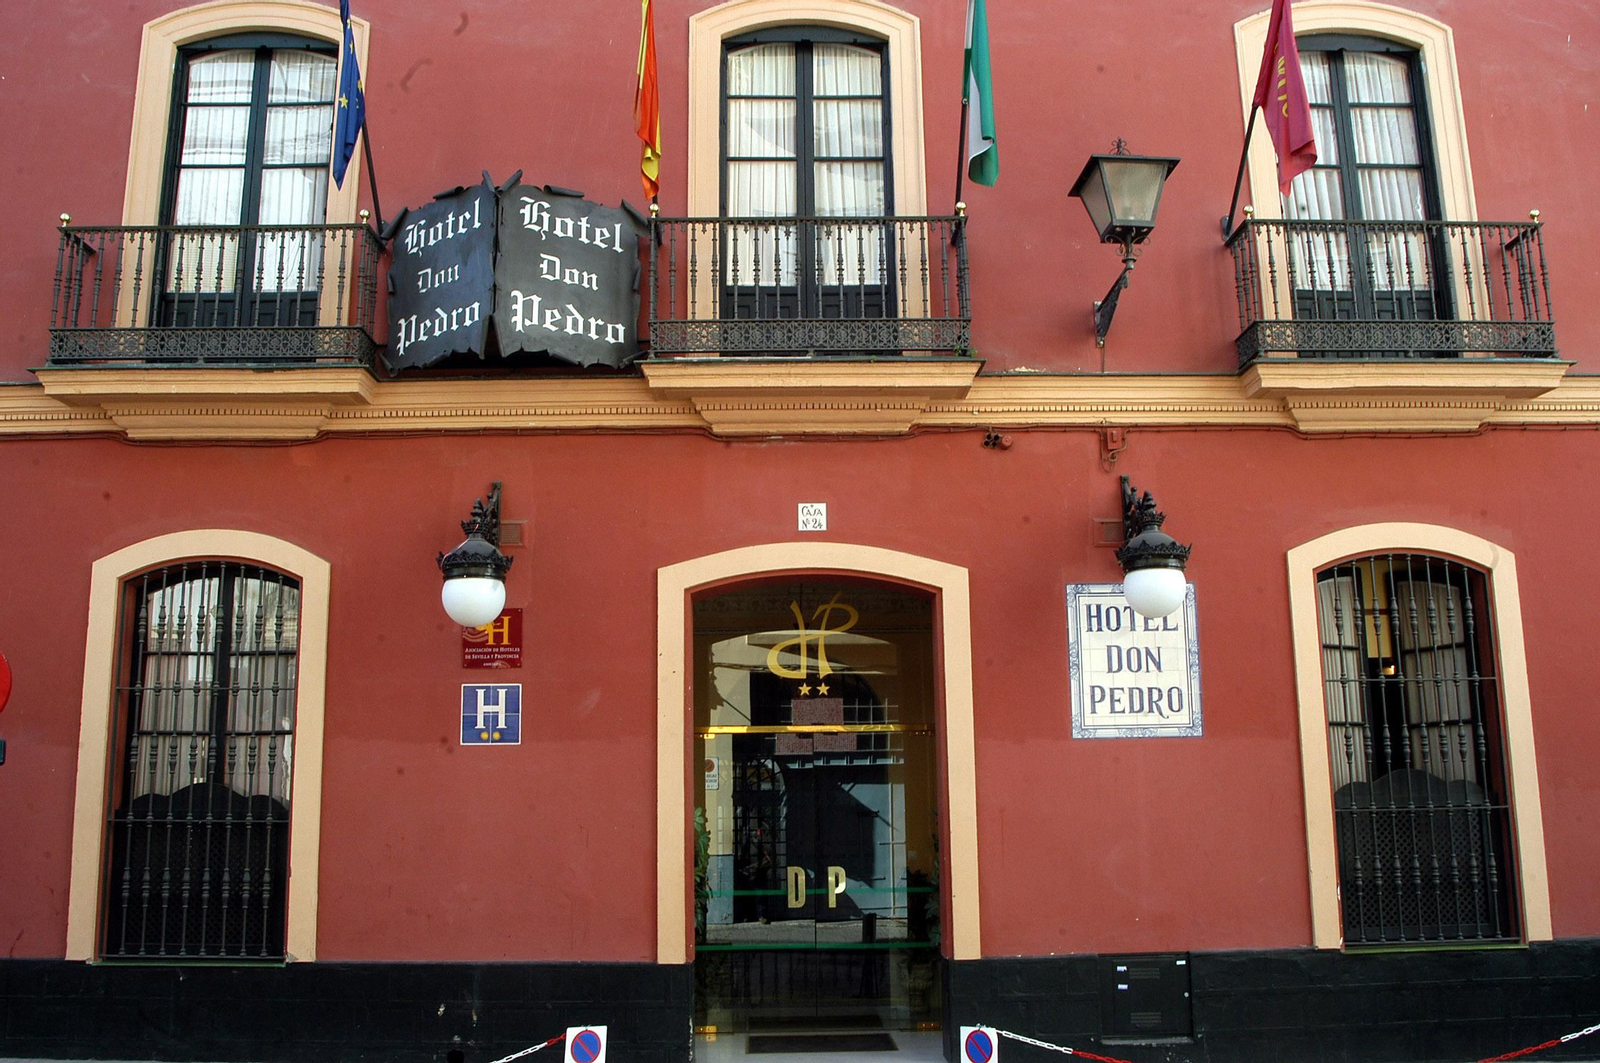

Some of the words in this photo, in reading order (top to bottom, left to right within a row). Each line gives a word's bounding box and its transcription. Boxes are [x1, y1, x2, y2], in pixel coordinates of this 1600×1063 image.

[405, 197, 482, 257] Hotel
[519, 196, 624, 253] Hotel
[417, 264, 460, 293] Don
[539, 253, 599, 291] Don
[396, 301, 481, 356] Pedro
[510, 290, 626, 344] Pedro
[811, 518, 824, 529] 24
[1106, 645, 1163, 673] DON
[474, 688, 508, 729] H
[1089, 685, 1184, 719] PEDRO
